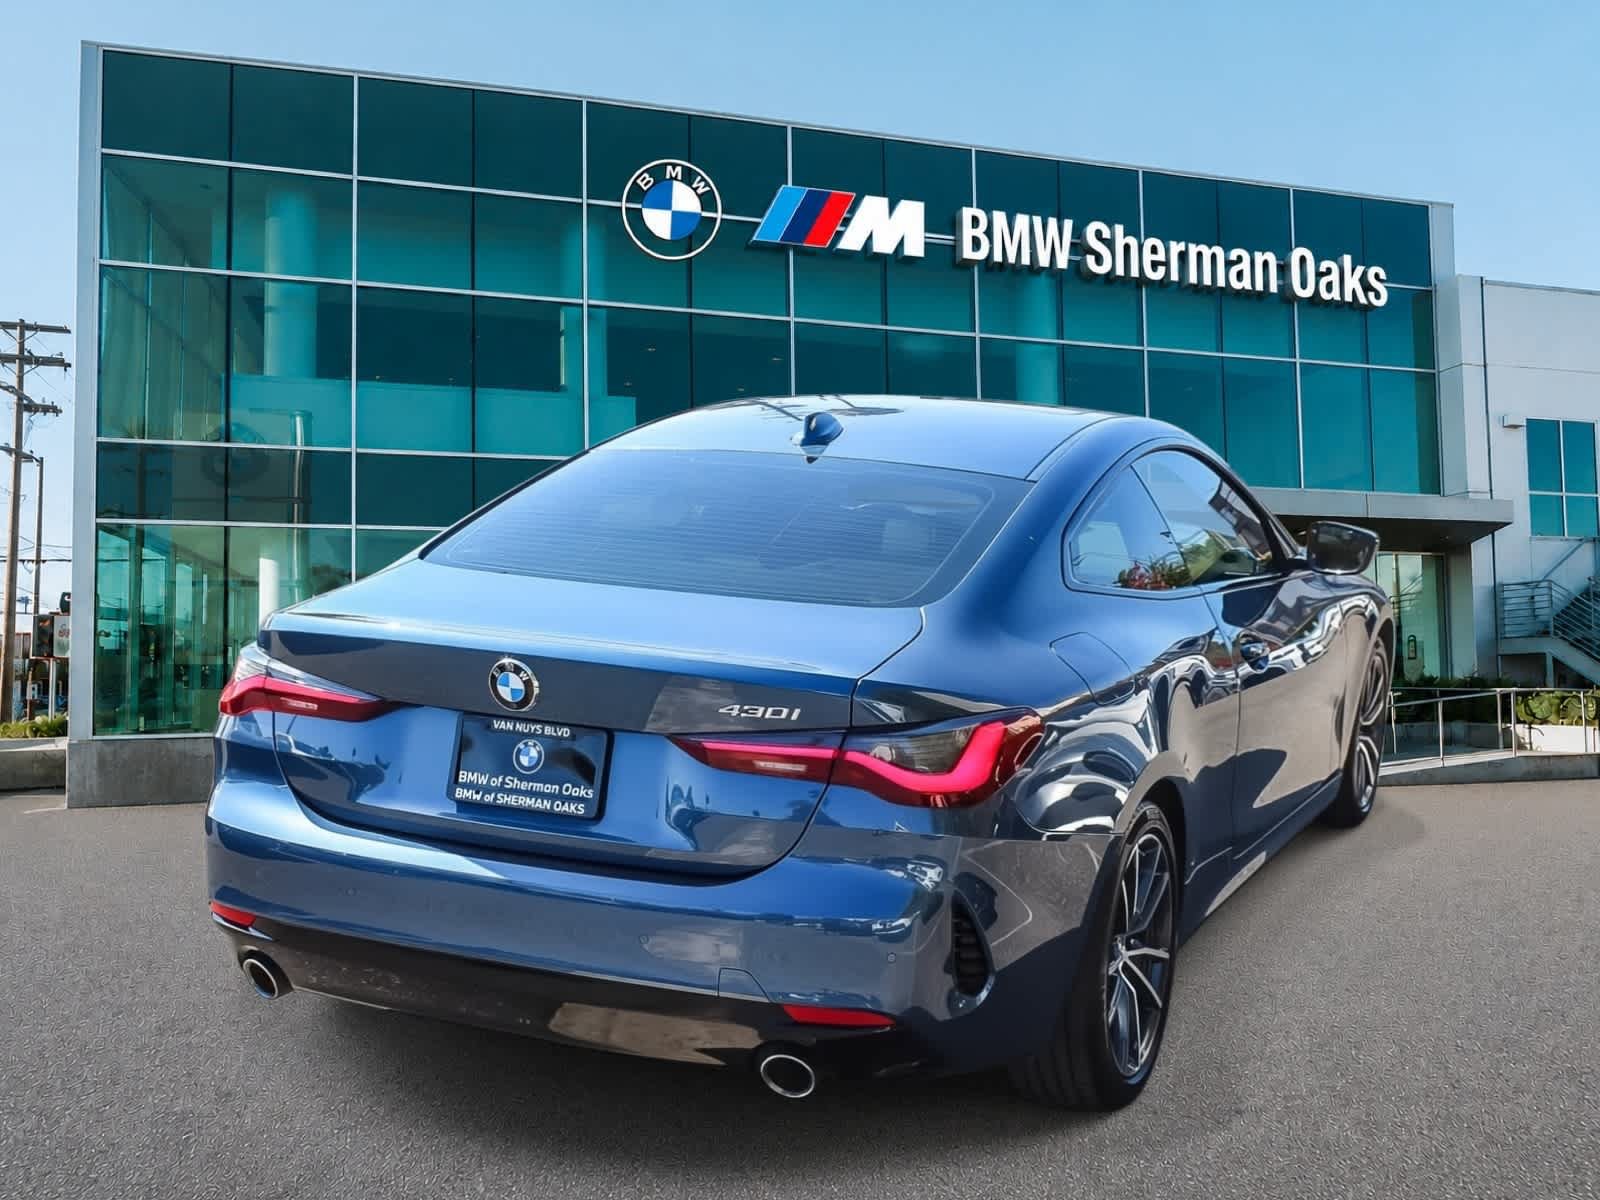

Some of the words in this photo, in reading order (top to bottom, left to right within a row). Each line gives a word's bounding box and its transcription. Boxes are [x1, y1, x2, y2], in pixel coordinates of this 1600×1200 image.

[636, 165, 711, 196] BMW
[836, 194, 925, 257] M
[960, 206, 1073, 270] BMW
[1083, 220, 1278, 294] Sherman
[1289, 246, 1389, 308] Oaks
[493, 719, 514, 731] VAN
[515, 723, 542, 735] NUYS
[544, 726, 570, 737] BLVD
[458, 771, 488, 785] BMW
[490, 775, 503, 786] of
[504, 776, 559, 794] Sherman
[562, 783, 594, 798] Oaks
[455, 788, 482, 801] BMW
[484, 792, 495, 802] of
[496, 792, 551, 810] SHERMAN
[554, 801, 585, 815] OAKS
